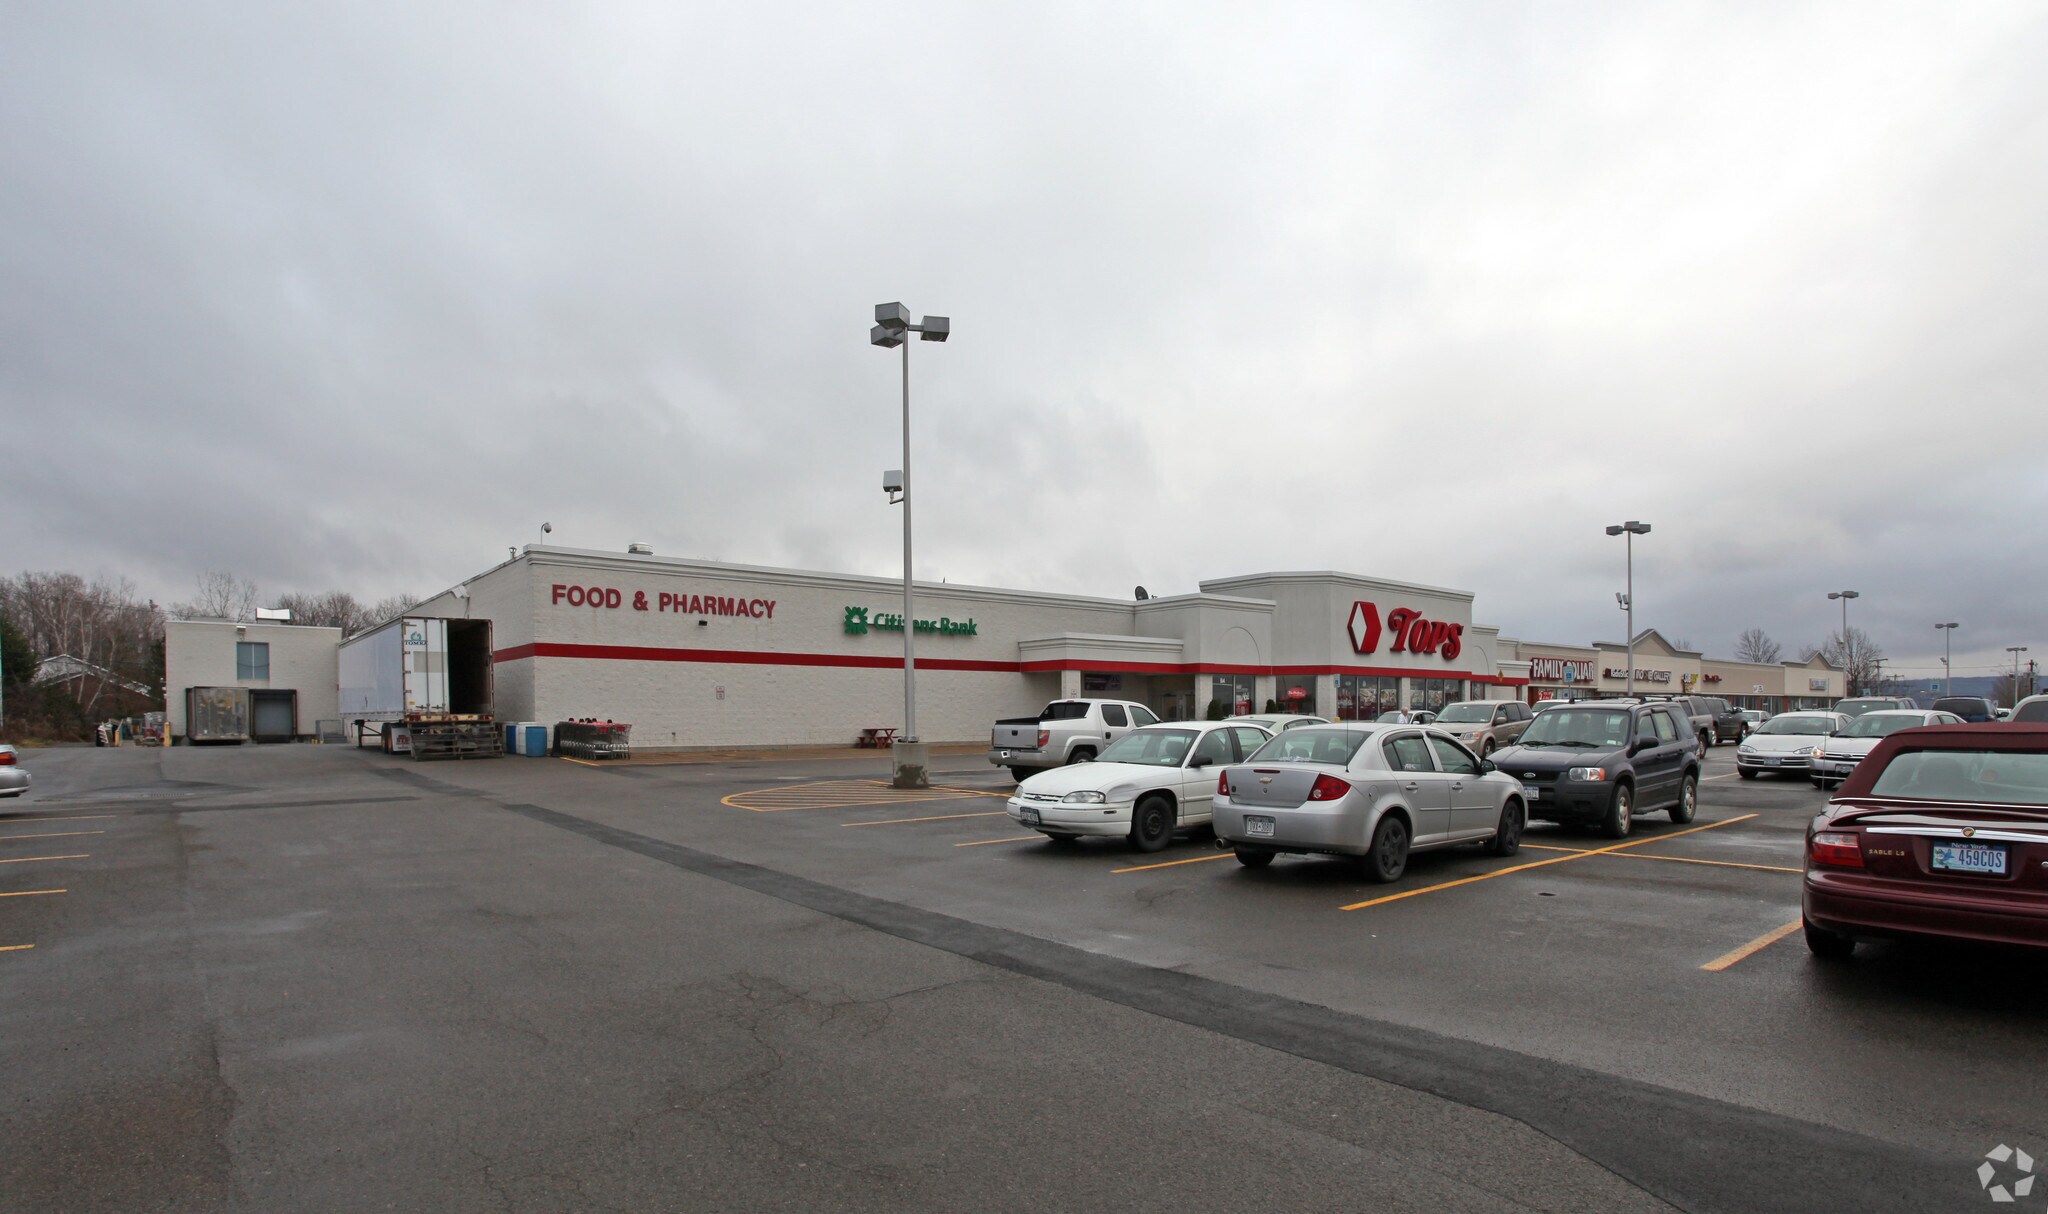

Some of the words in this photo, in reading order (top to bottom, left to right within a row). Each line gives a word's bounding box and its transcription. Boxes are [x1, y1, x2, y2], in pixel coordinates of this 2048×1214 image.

[552, 584, 621, 609] FOOD
[632, 590, 648, 611] &
[659, 592, 776, 618] PHARMACY
[873, 612, 937, 634] Citiens
[940, 617, 977, 636] Bank
[1532, 658, 1564, 679] FAMILY
